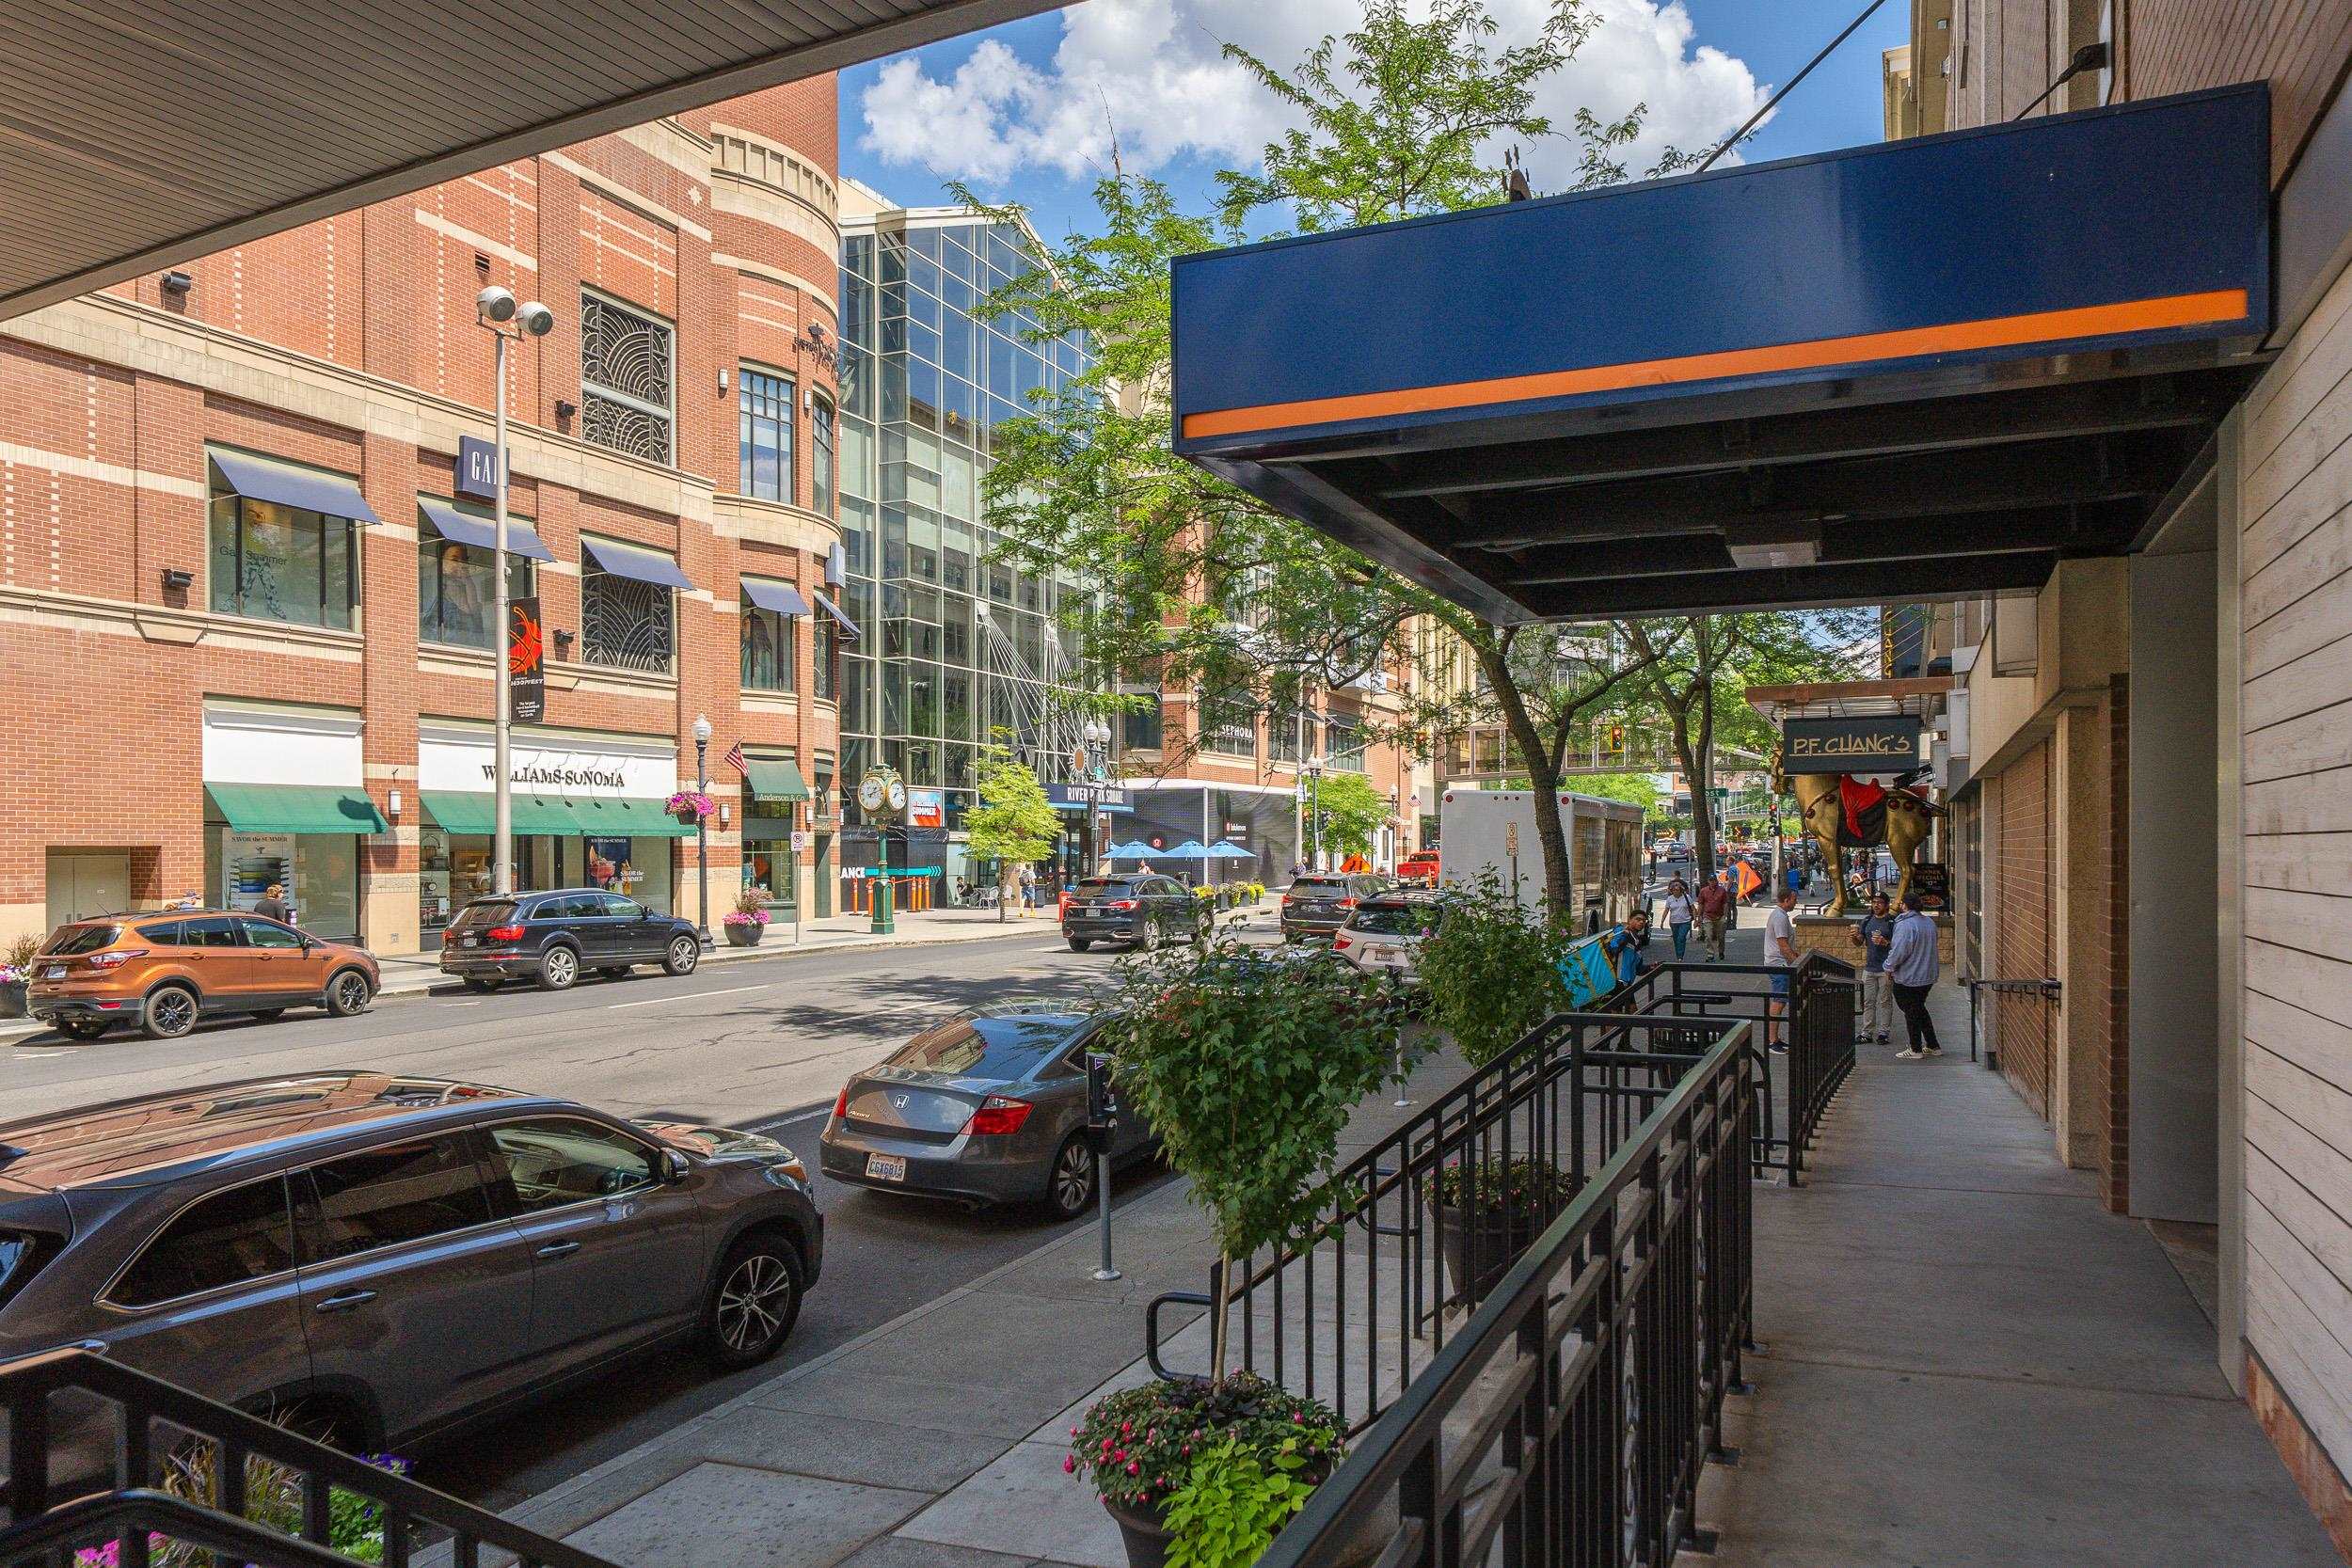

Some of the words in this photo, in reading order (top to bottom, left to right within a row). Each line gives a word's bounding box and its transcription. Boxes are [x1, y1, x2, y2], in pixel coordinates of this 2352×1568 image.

[1222, 724, 1253, 739] SEPHORA
[1793, 737, 1820, 756] P.F.
[1824, 734, 1911, 755] CHANG'S
[482, 765, 625, 787] WLIAMS-SONOMA
[1067, 786, 1089, 801] RIVER
[1089, 788, 1105, 802] PRK
[913, 806, 936, 816] SUMMER
[849, 1110, 871, 1118] Accord
